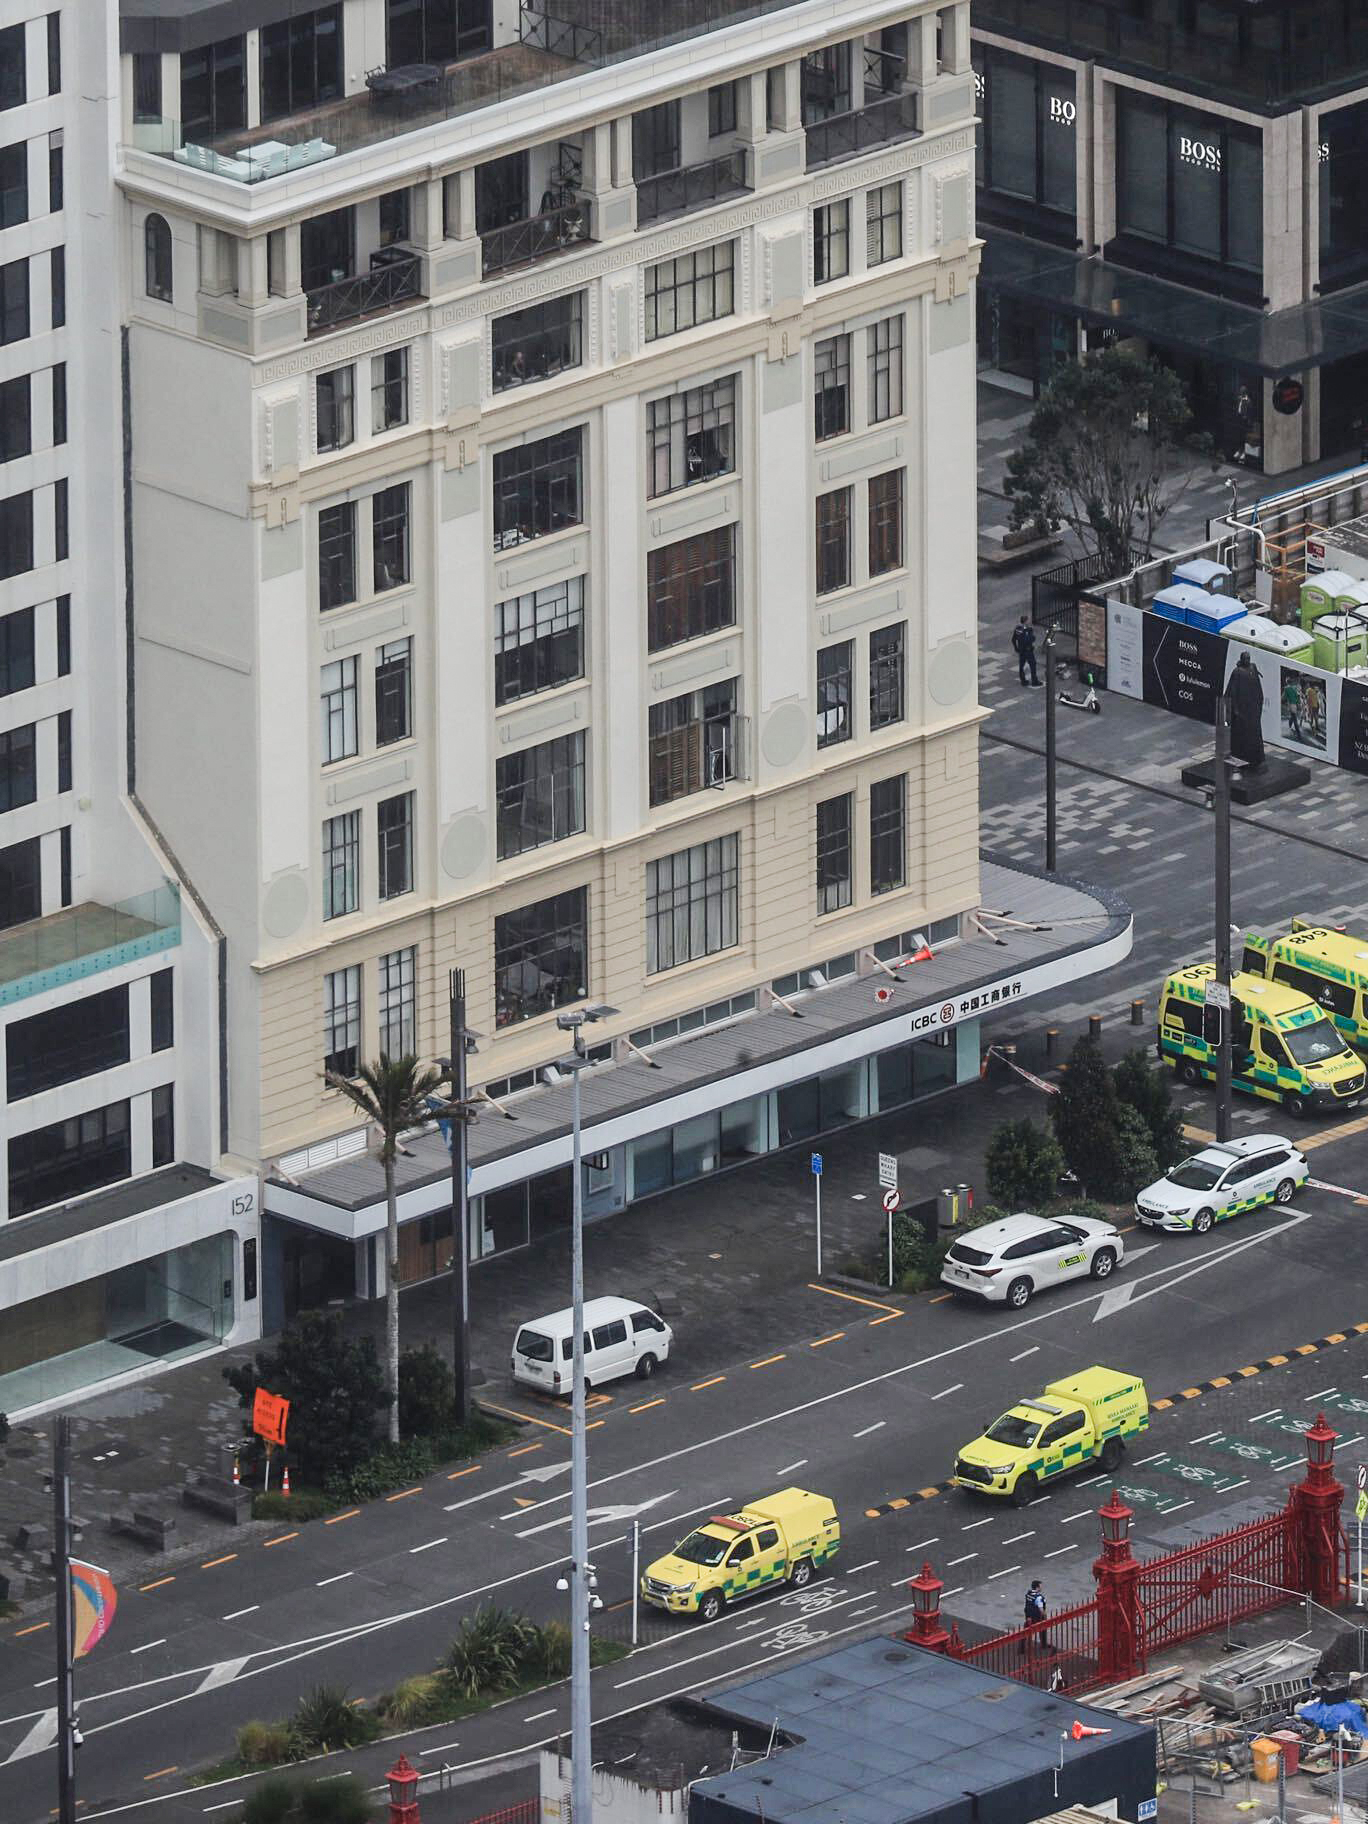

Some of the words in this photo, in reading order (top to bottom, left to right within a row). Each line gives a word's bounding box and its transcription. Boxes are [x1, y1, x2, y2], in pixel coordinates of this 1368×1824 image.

[1179, 640, 1198, 652] BOSS
[1178, 657, 1201, 670] MECCA
[1178, 690, 1194, 701] COS
[1289, 930, 1328, 945] 648
[911, 1013, 937, 1031] ICBC
[880, 1155, 896, 1165] QUEENS
[880, 1162, 896, 1170] WHARF
[232, 1193, 254, 1216] 152
